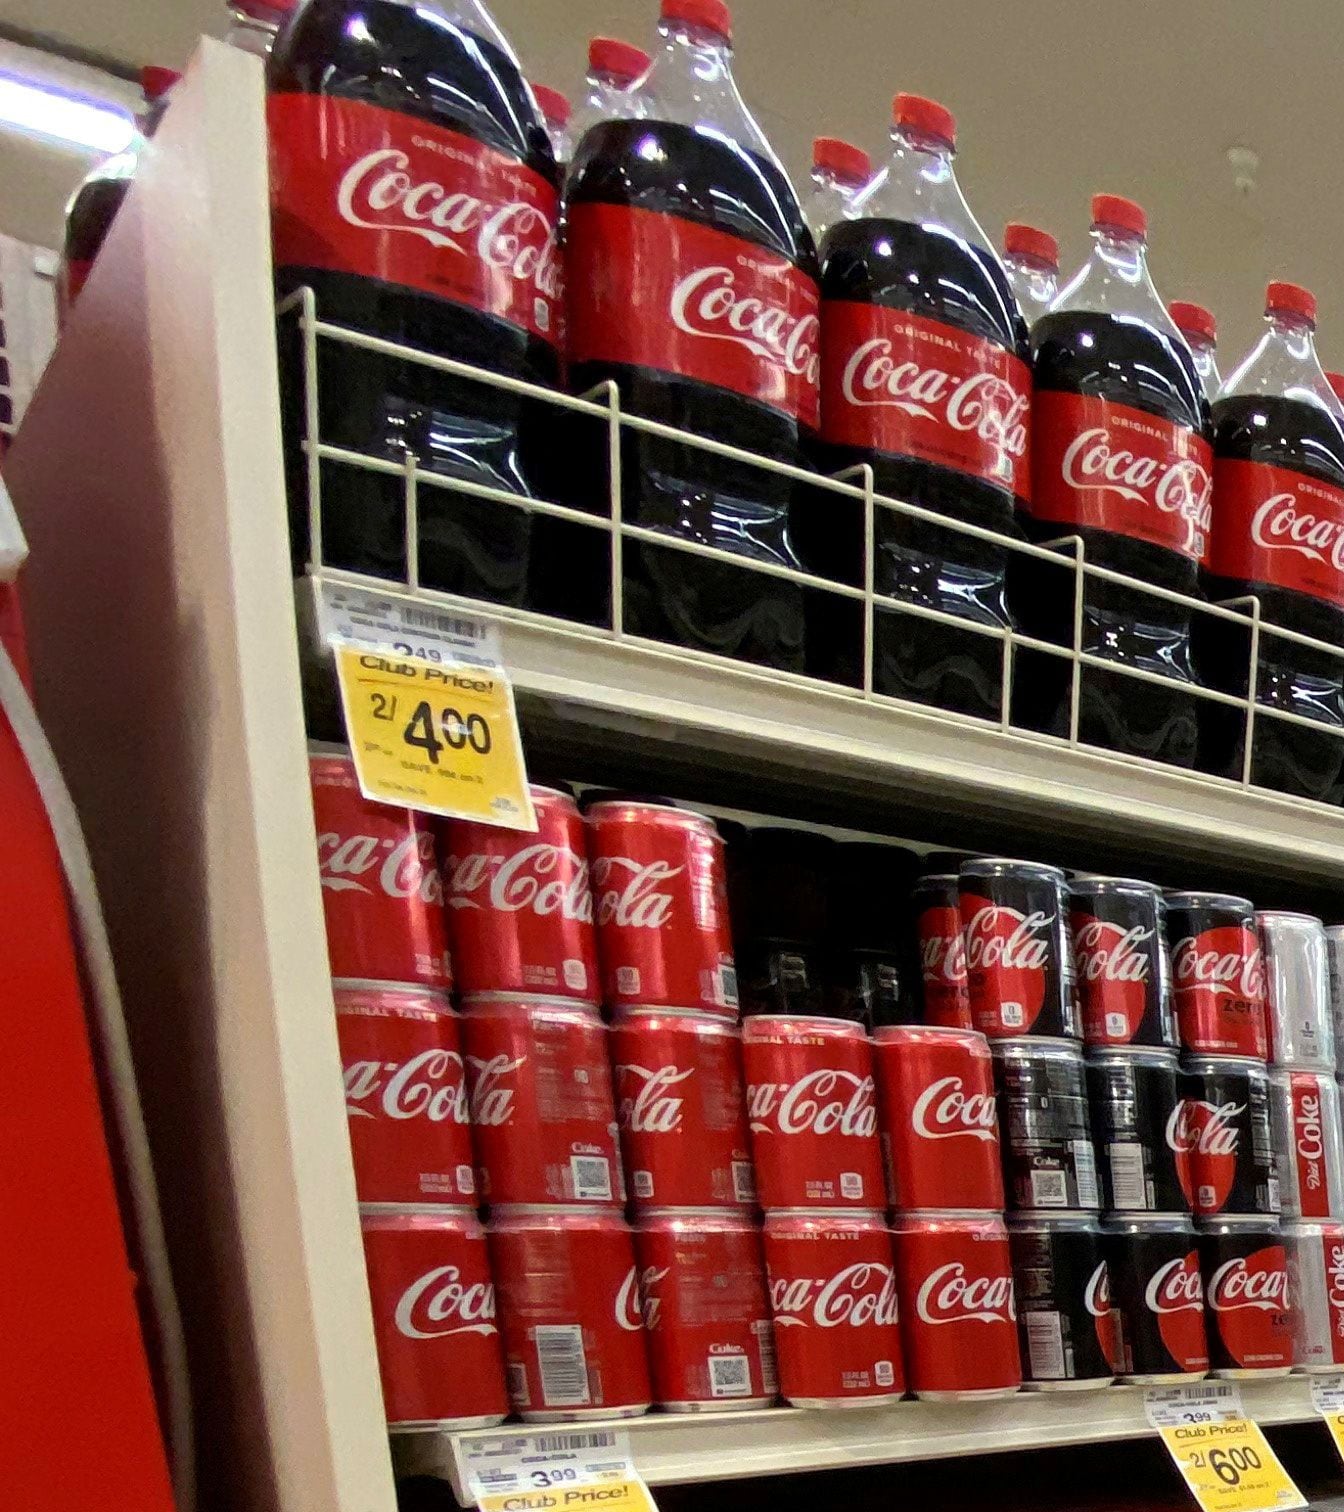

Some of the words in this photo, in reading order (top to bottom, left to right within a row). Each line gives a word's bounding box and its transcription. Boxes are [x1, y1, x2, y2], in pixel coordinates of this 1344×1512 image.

[360, 655, 418, 679] Club
[424, 667, 494, 694] Price!
[1174, 1426, 1205, 1439] Club
[1209, 1424, 1248, 1436] Price!
[503, 1496, 557, 1512] Club
[564, 1485, 629, 1506] Price!
